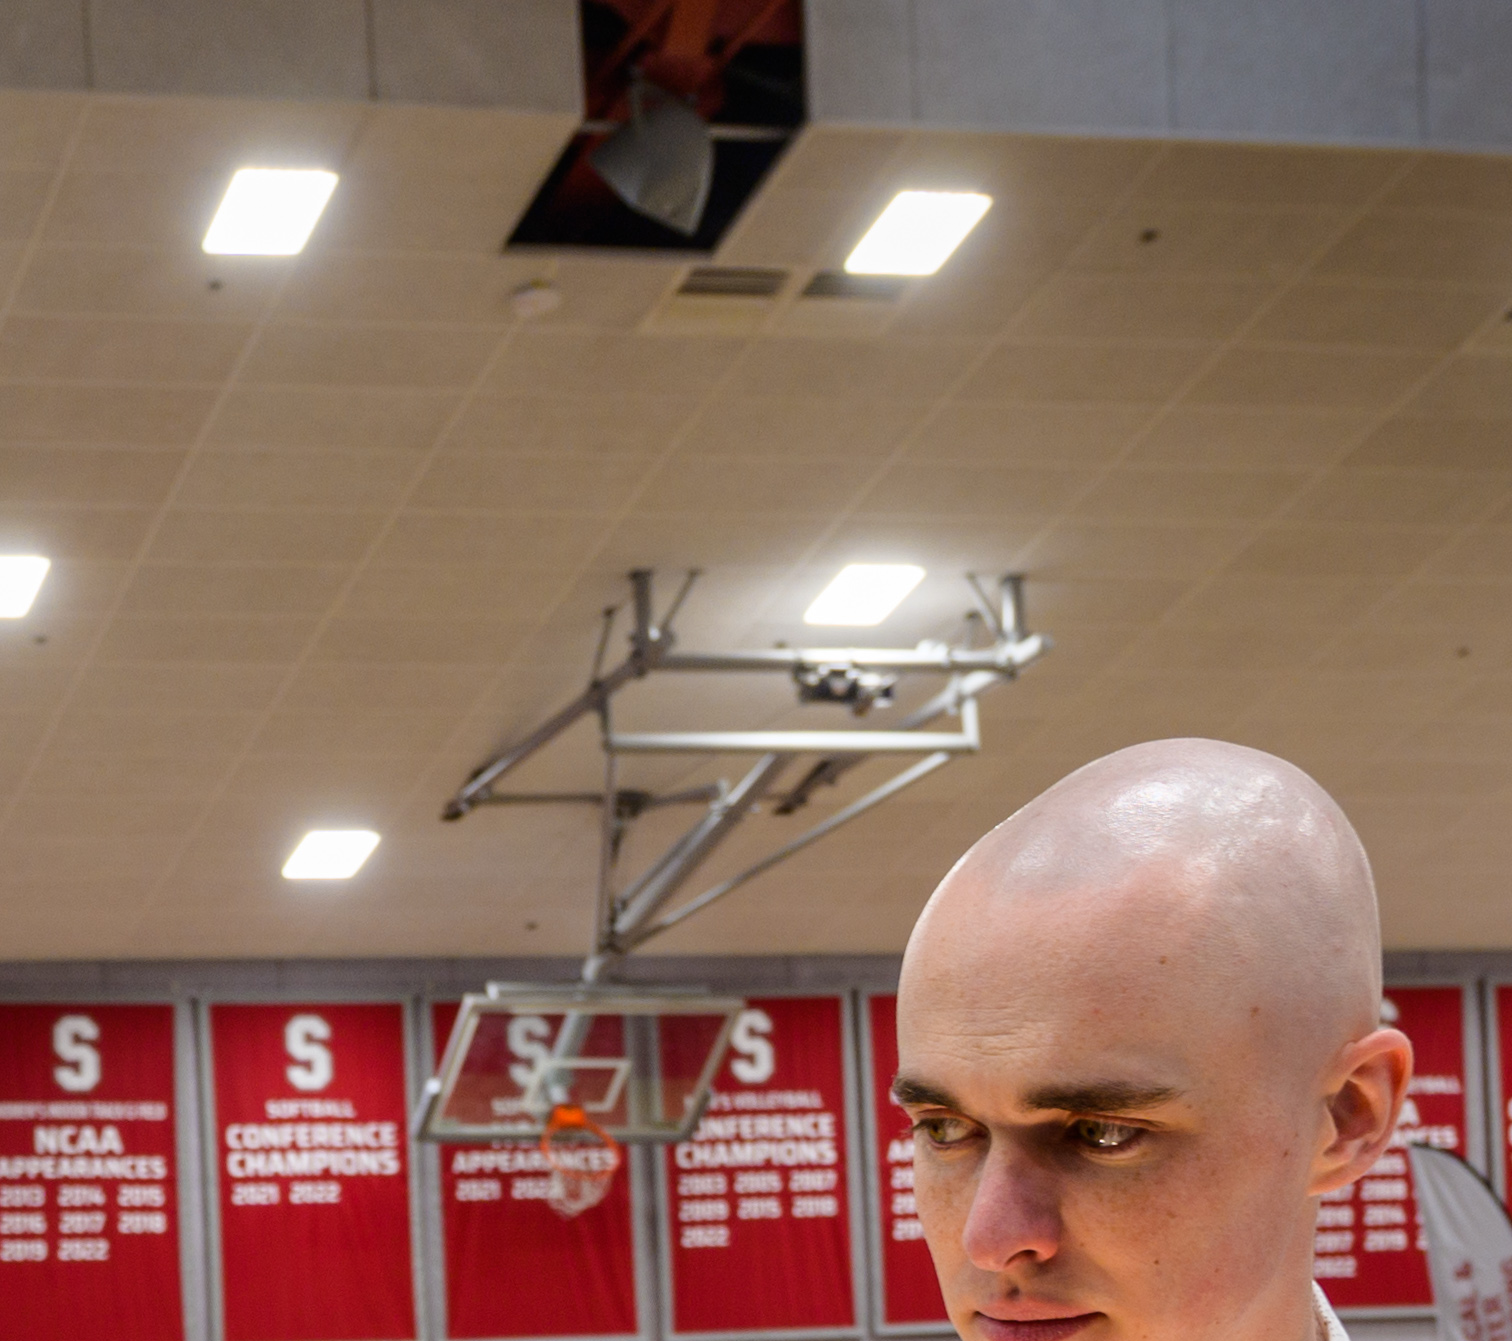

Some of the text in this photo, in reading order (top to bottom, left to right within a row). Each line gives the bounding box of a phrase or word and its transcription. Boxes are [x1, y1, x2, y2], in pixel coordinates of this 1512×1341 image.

[52, 1014, 103, 1093] S
[283, 1013, 336, 1093] S
[730, 1008, 776, 1085] S
[264, 1098, 358, 1120] SOFTBALL
[33, 1124, 125, 1155] NCAA
[225, 1121, 399, 1150] CONFERENCE
[226, 1149, 401, 1178] CHAMPIONS
[675, 1138, 838, 1170] CHAMPIONS
[57, 1184, 106, 1208] 2014
[231, 1180, 342, 1207] 2021 2022
[58, 1211, 106, 1235] 2017
[57, 1238, 110, 1262] 2022
